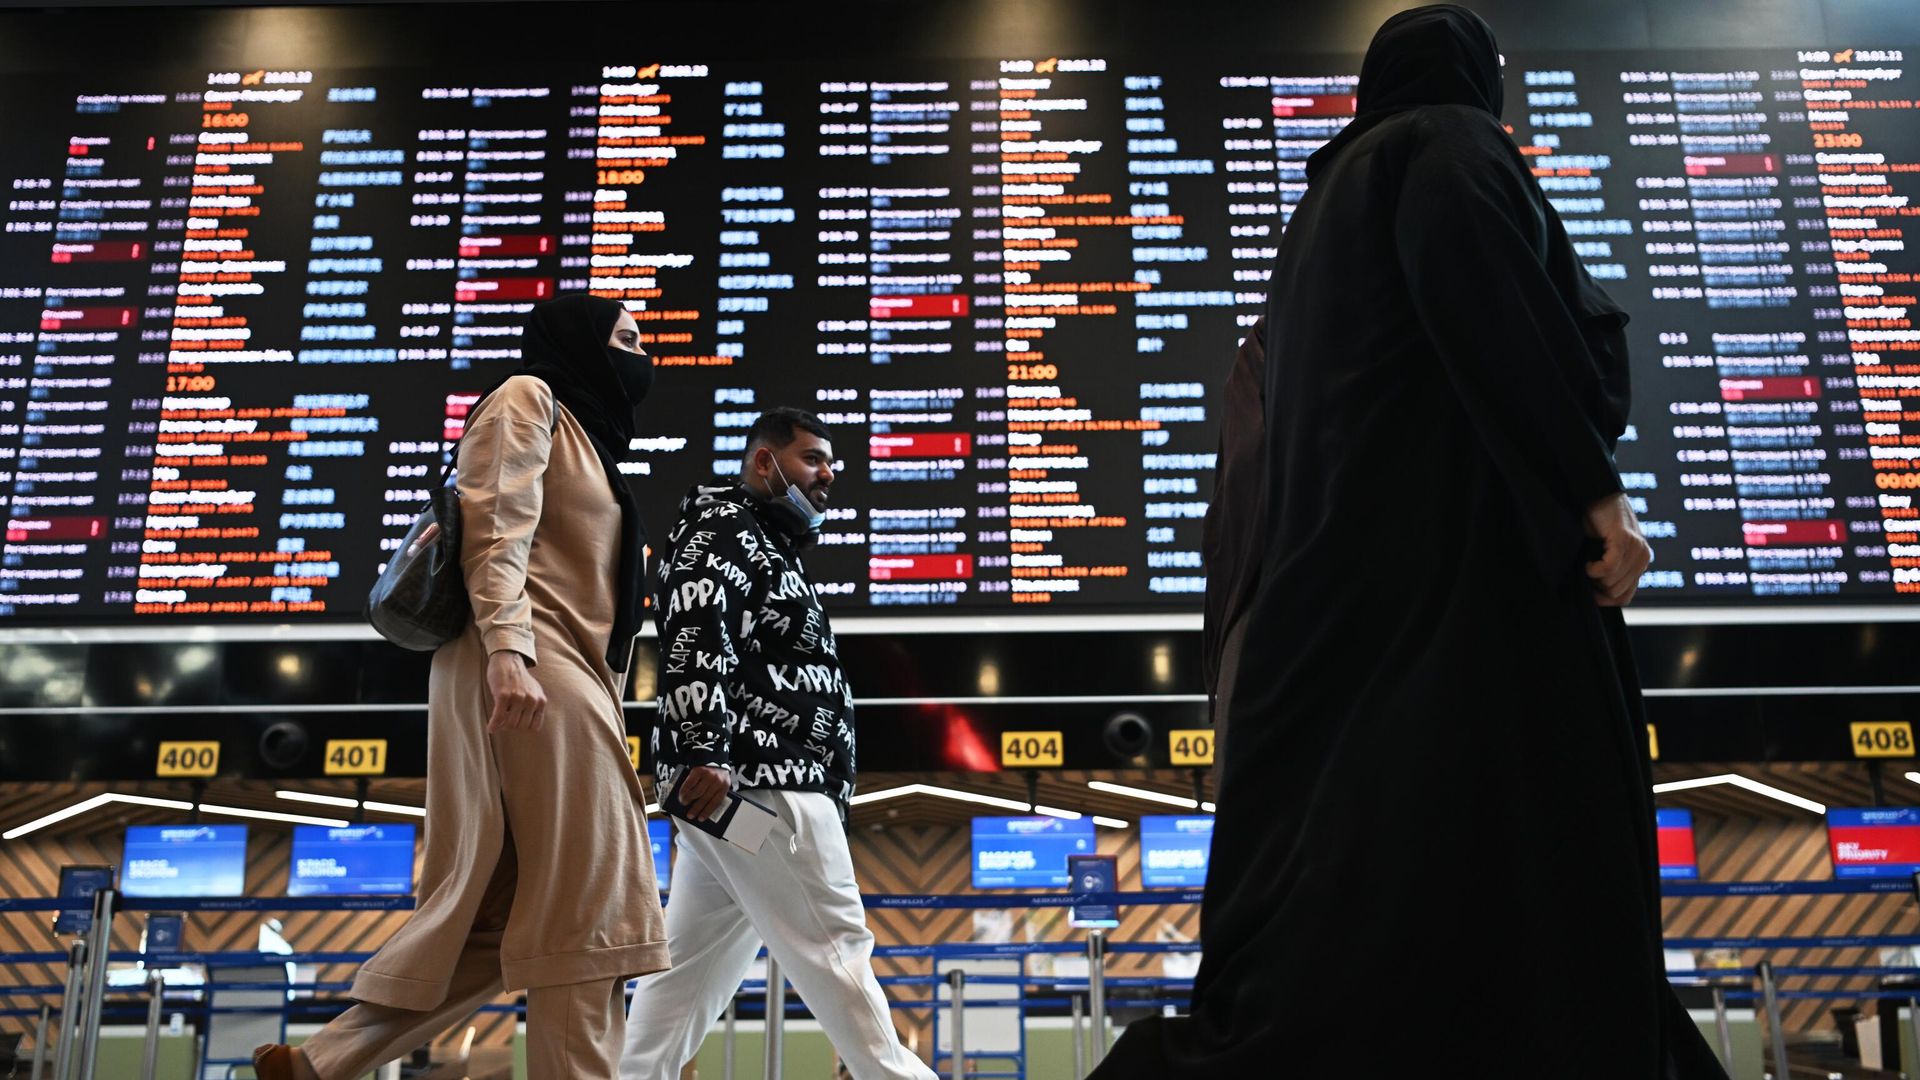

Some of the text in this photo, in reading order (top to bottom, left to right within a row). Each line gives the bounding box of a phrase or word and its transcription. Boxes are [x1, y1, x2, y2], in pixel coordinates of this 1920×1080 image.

[202, 113, 249, 127] 16:00
[1813, 133, 1863, 148] 23:00
[1008, 364, 1057, 380] 21:00
[166, 376, 215, 391] 17:00
[675, 530, 717, 571] KAPPA
[706, 552, 753, 597] KAPPA
[666, 577, 727, 621] APPA
[666, 626, 701, 674] KAPPA
[663, 680, 727, 724] APPA
[1006, 737, 1060, 760] 404
[1856, 728, 1911, 751] 408
[163, 748, 215, 770] 400
[330, 746, 381, 768] 401
[1838, 849, 1888, 861] PRIORITY
